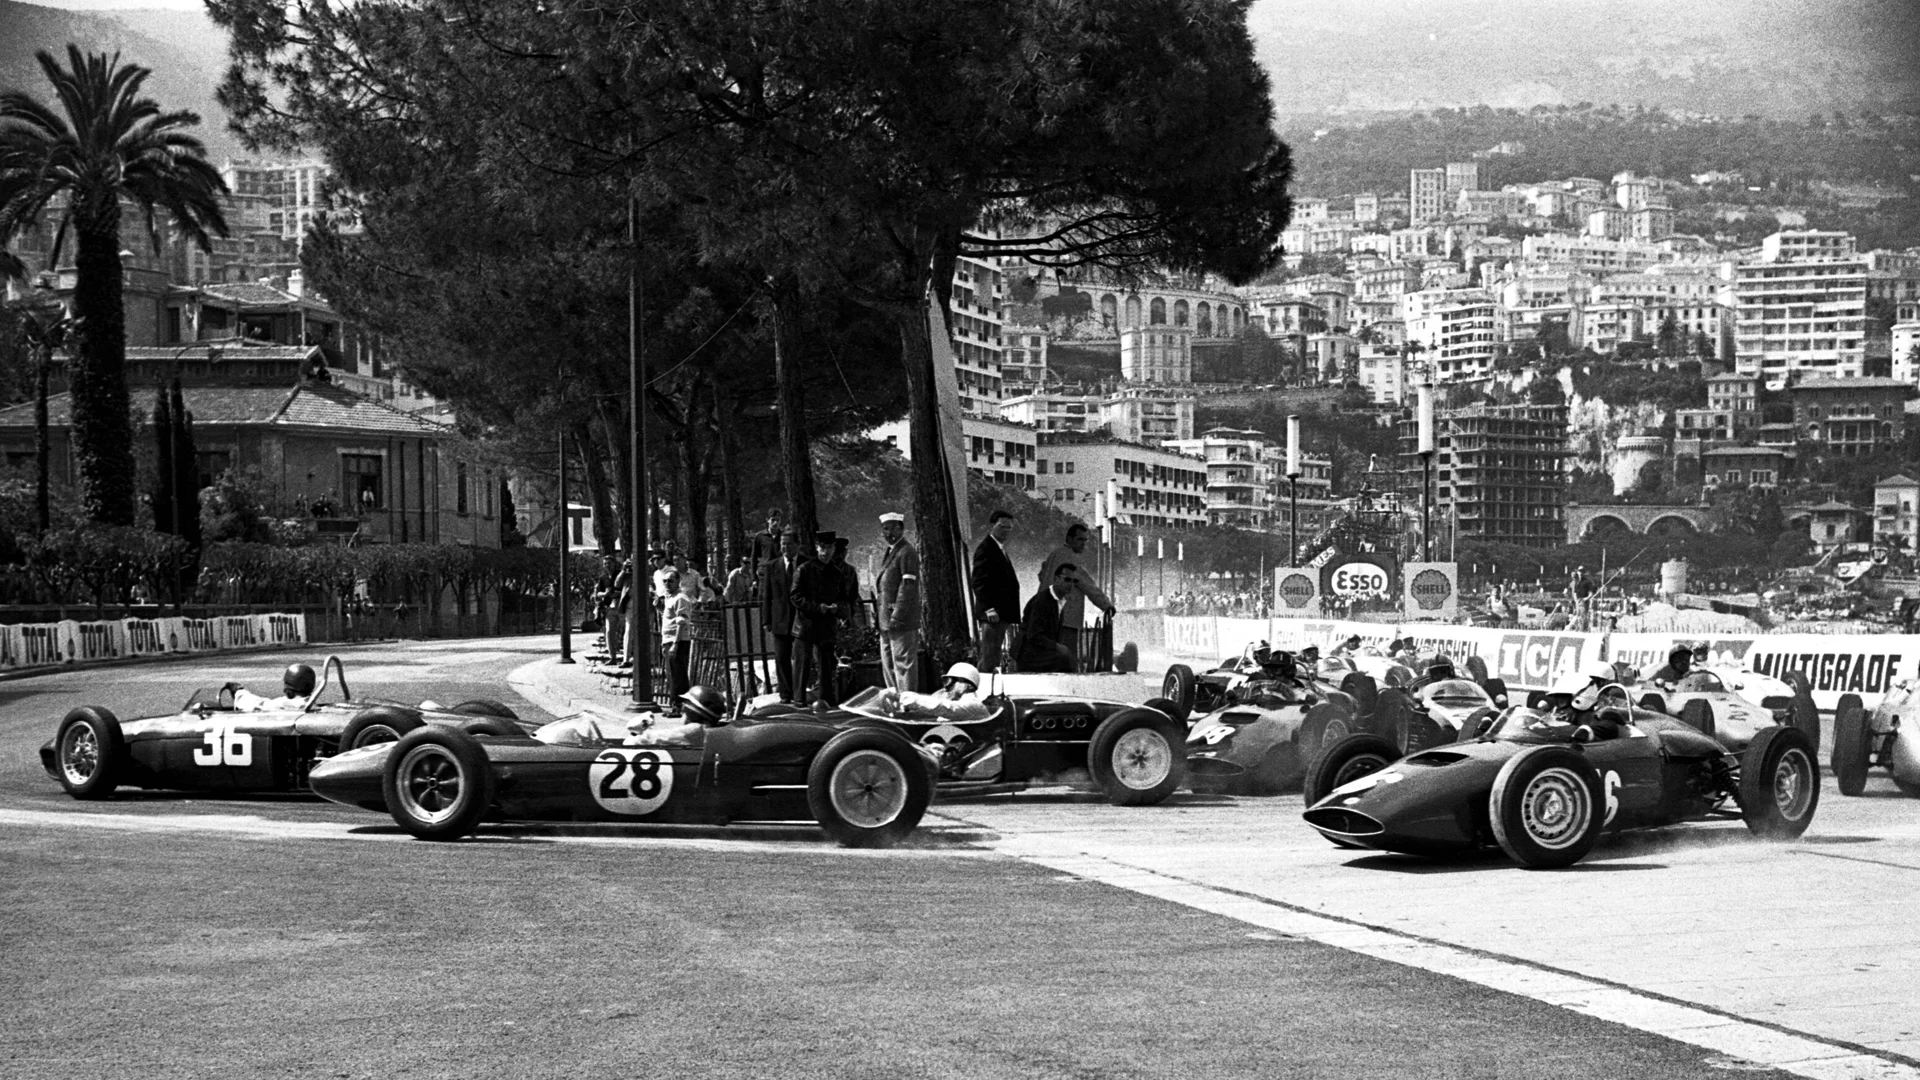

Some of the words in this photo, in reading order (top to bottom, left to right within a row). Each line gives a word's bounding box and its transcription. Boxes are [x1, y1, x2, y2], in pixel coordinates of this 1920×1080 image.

[1284, 586, 1309, 595] SHELL
[1416, 584, 1446, 594] SHELL
[22, 626, 63, 664] TOTAL
[80, 624, 118, 658] TOTAL
[127, 620, 165, 653] TOTAL
[183, 619, 217, 649] TOTAL
[227, 618, 256, 646] TOTAL
[269, 615, 301, 642] TOTAL
[193, 721, 252, 766] 36
[599, 751, 662, 799] 28
[1595, 768, 1622, 827] 6
